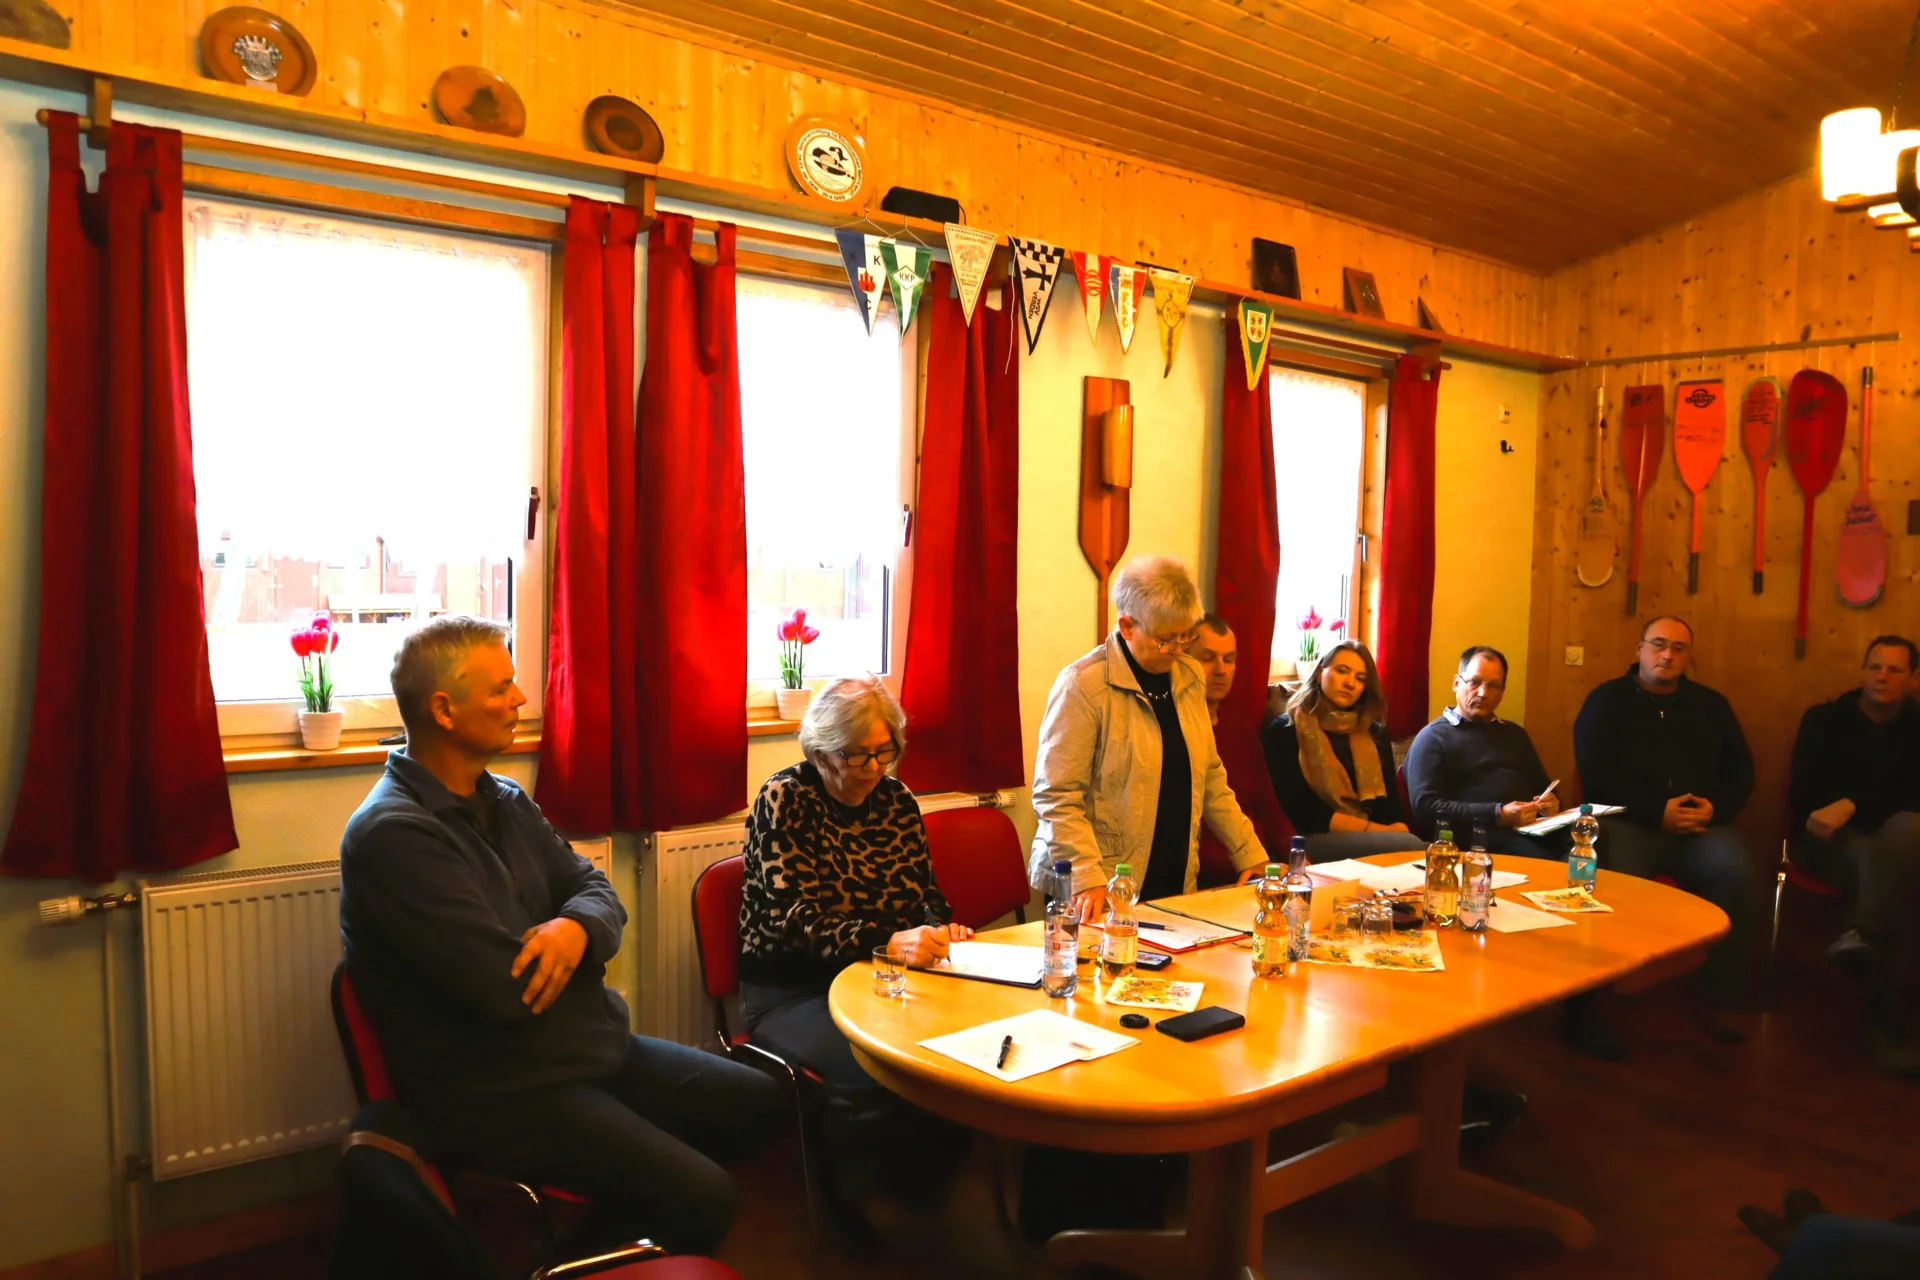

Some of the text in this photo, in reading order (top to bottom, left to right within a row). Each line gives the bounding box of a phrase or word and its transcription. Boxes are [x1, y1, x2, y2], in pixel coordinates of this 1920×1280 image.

[873, 255, 881, 266] K
[899, 272, 915, 283] KKP
[864, 299, 872, 310] C
[1028, 291, 1038, 320] VERDEN
